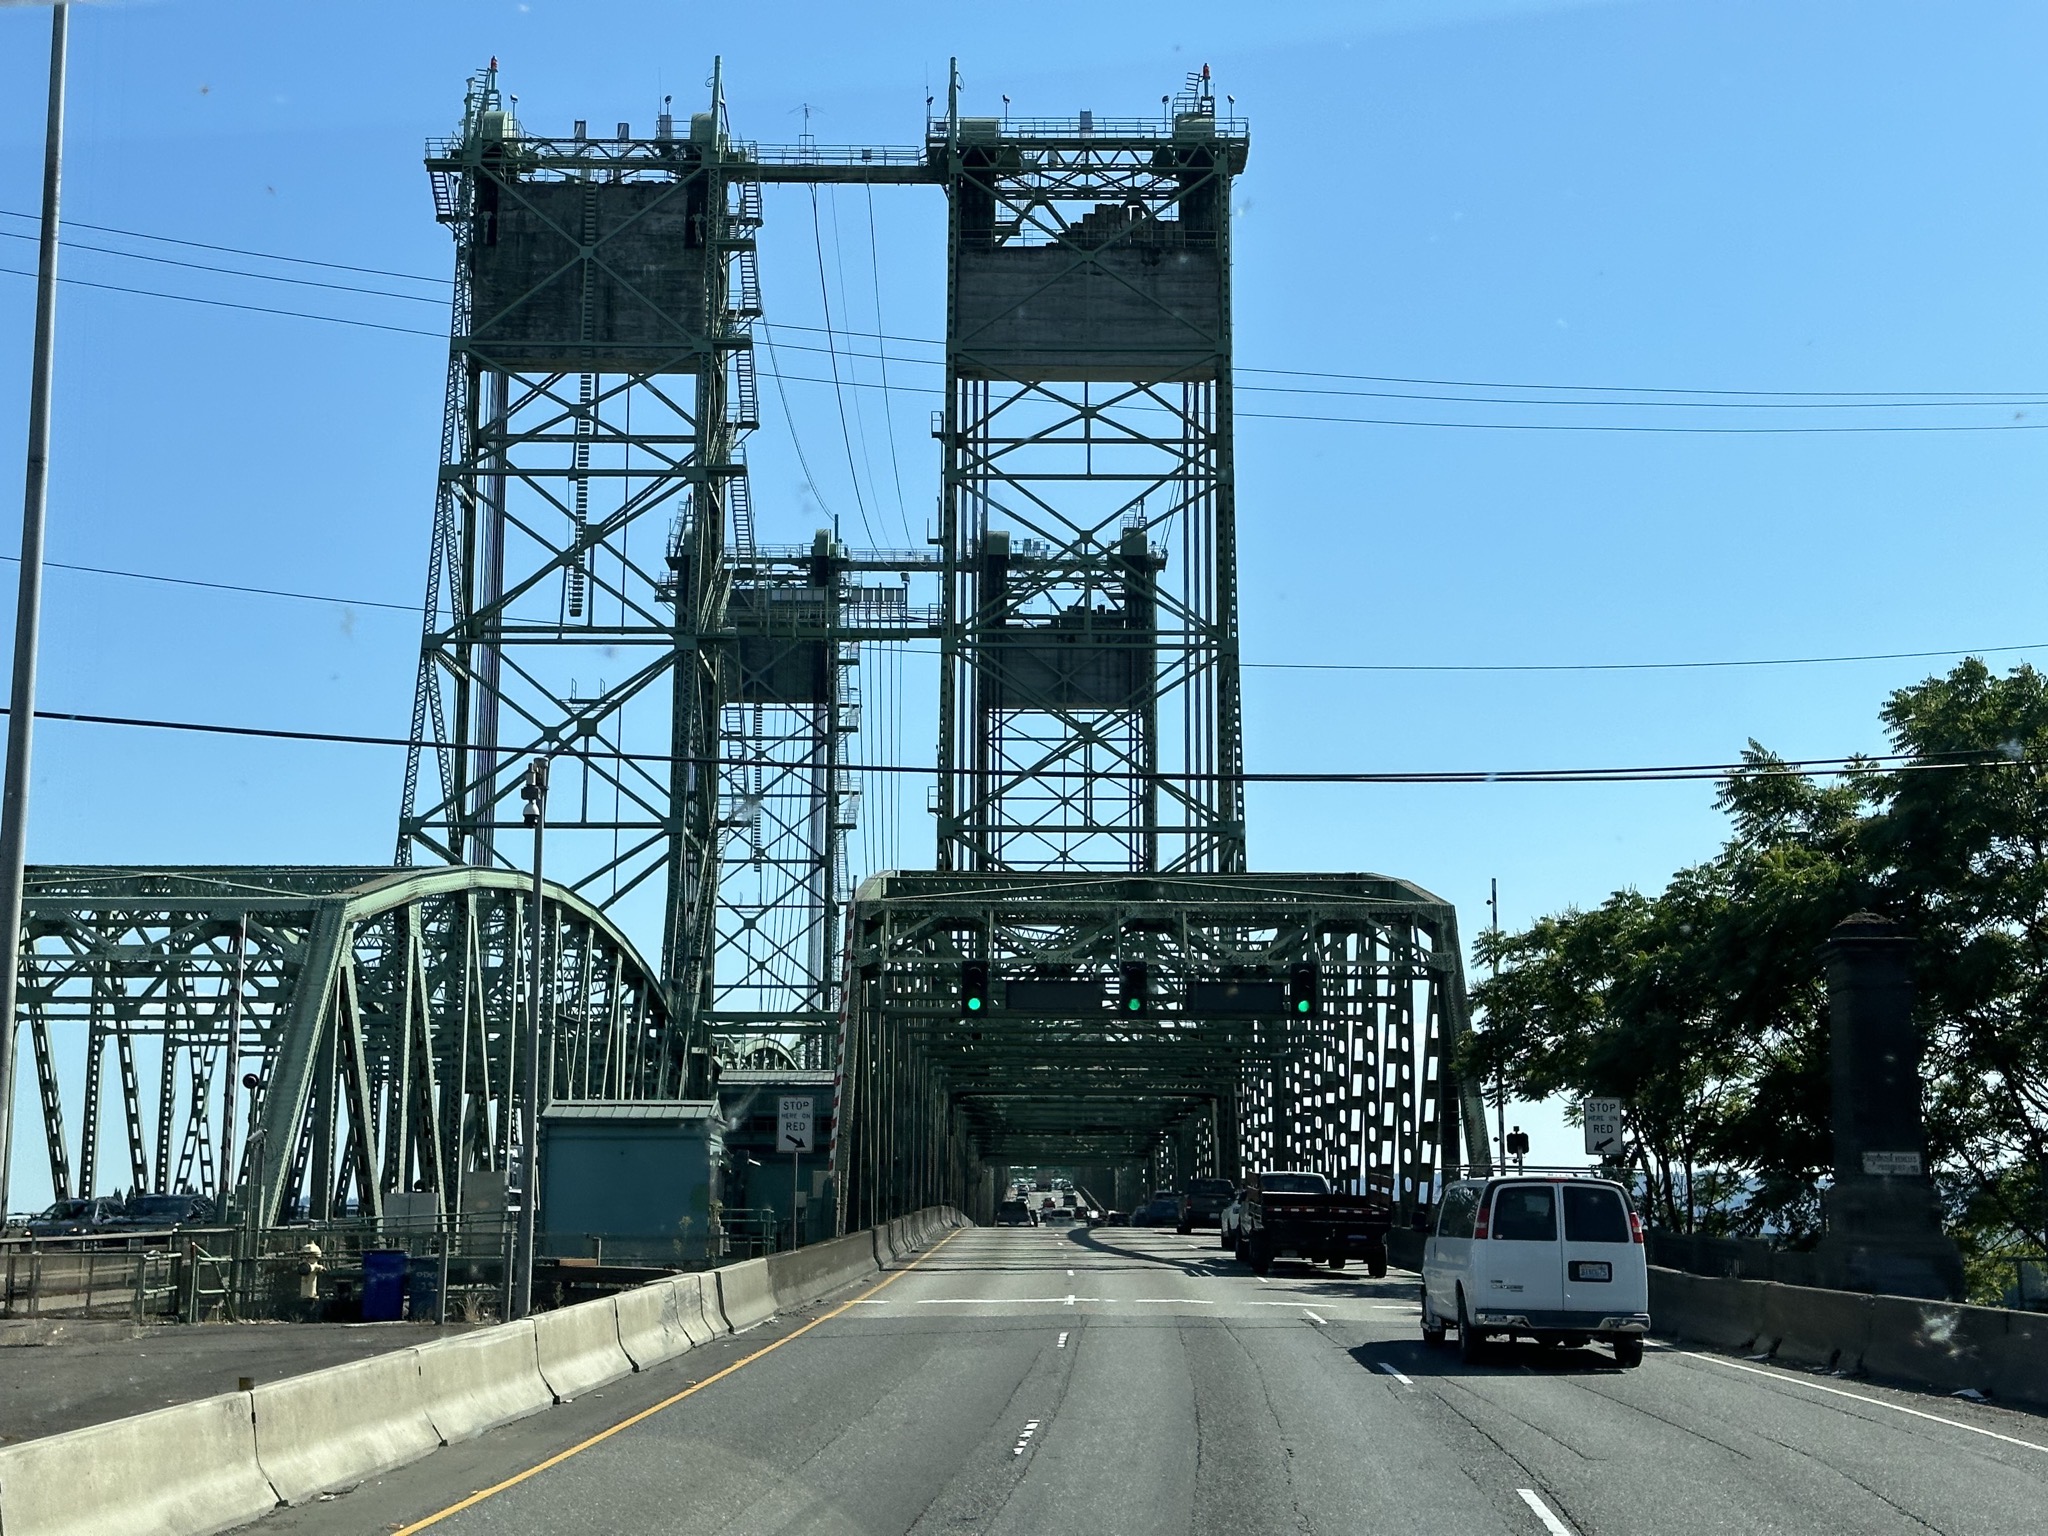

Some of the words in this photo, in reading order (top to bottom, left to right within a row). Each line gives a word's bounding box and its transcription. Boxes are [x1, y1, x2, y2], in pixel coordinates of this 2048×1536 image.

[783, 1101, 810, 1111] STOP
[1589, 1103, 1616, 1113] STOP
[785, 1122, 806, 1131] RED
[1593, 1124, 1614, 1133] RED
